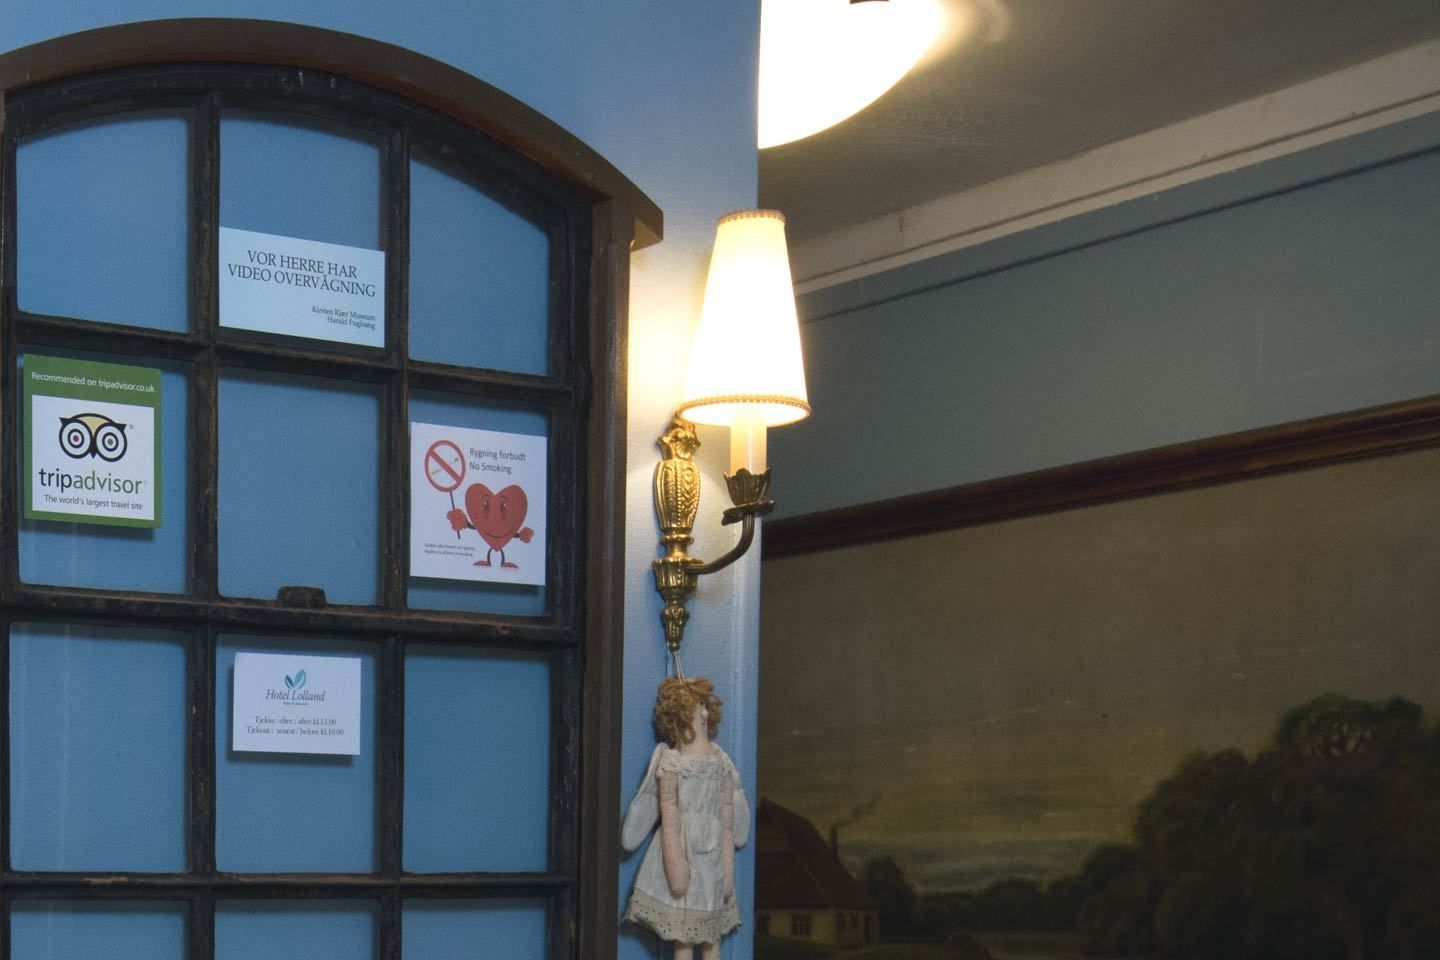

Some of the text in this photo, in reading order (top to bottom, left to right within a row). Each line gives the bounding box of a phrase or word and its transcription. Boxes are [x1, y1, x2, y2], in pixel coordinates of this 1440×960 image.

[247, 250, 358, 279] VOR HERRE HAR
[227, 263, 376, 298] VIDEO OVERVÅGNING
[350, 311, 376, 321] Museum
[31, 371, 86, 385] Recommended
[98, 379, 155, 393] tripadvisor.co.uk
[469, 447, 527, 462] Rygning forbudt
[469, 461, 512, 475] No Smoking
[38, 467, 143, 494] tripadvisor
[44, 494, 143, 511] The world's largest travel site
[265, 688, 326, 702] Hotel Lolland
